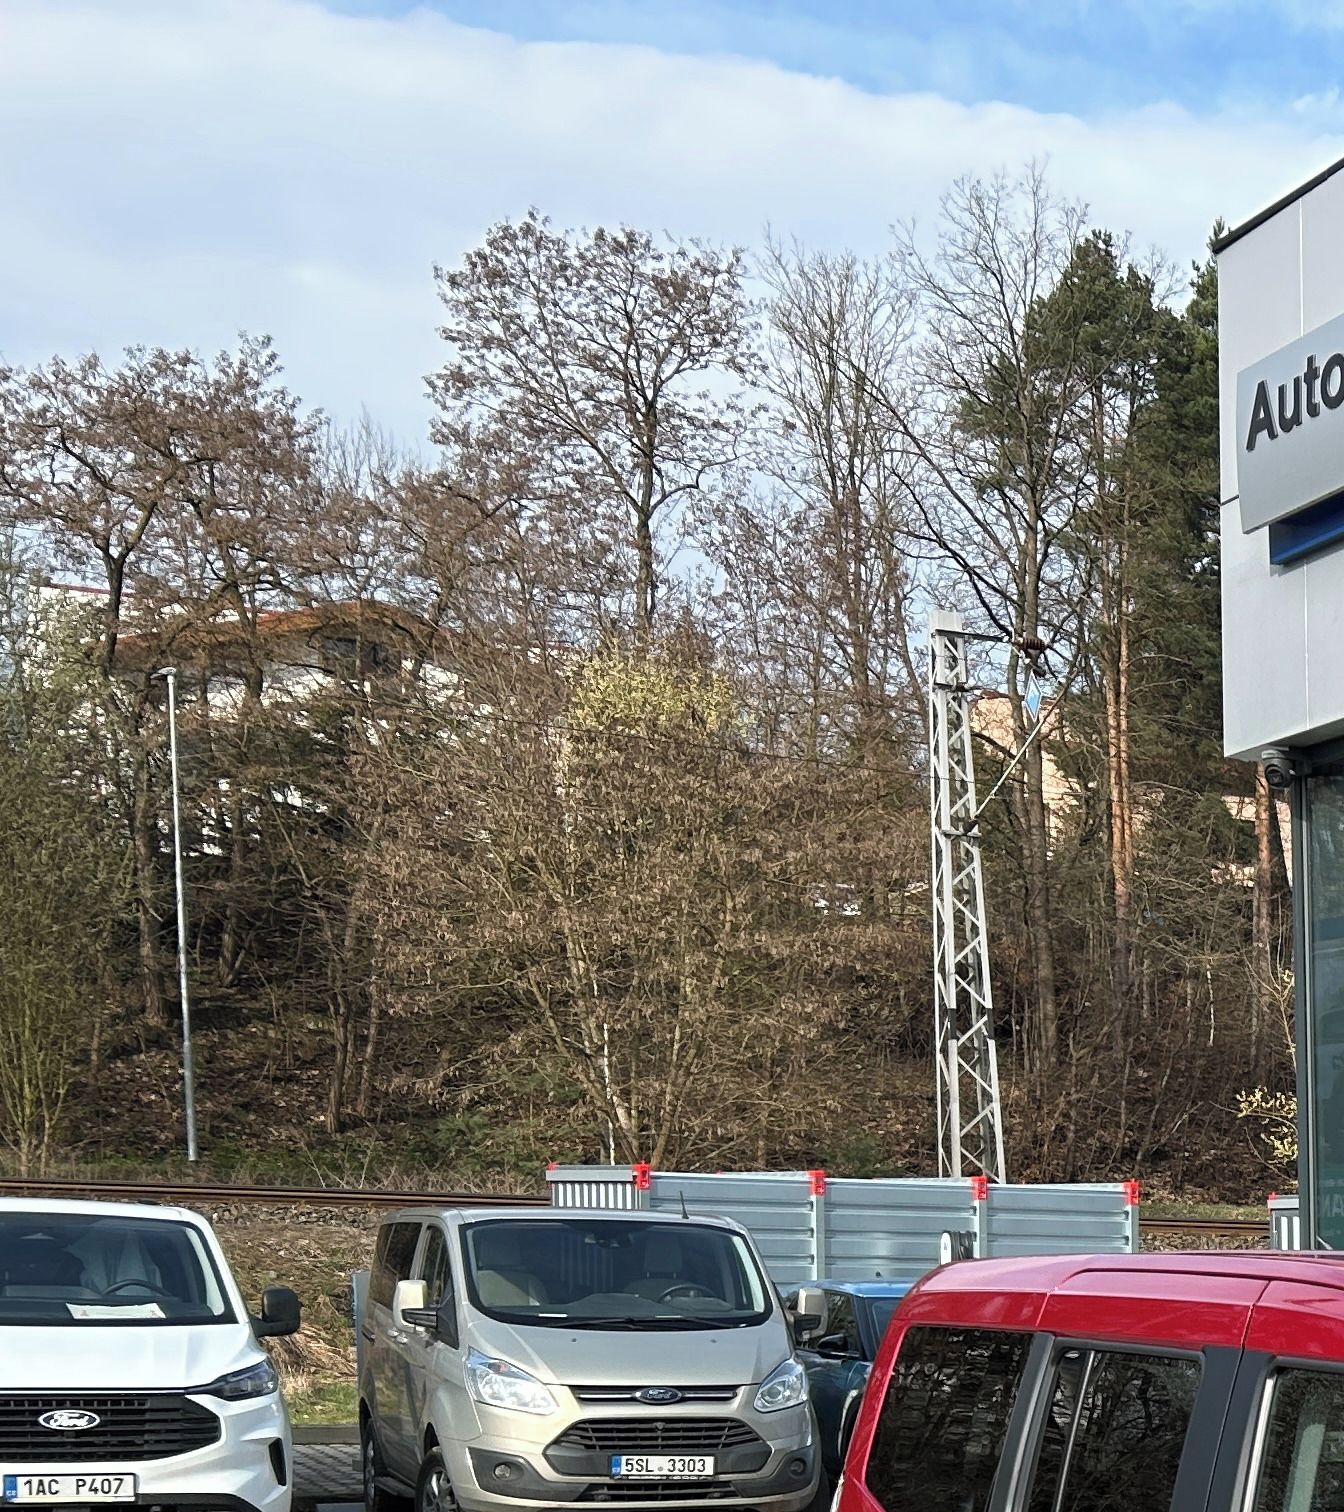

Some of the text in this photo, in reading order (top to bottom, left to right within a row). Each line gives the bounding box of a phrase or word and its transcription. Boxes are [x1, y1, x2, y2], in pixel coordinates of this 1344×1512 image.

[625, 1458, 654, 1473] 5SL
[667, 1458, 706, 1473] 3303
[24, 1477, 125, 1496] 1AC P407
